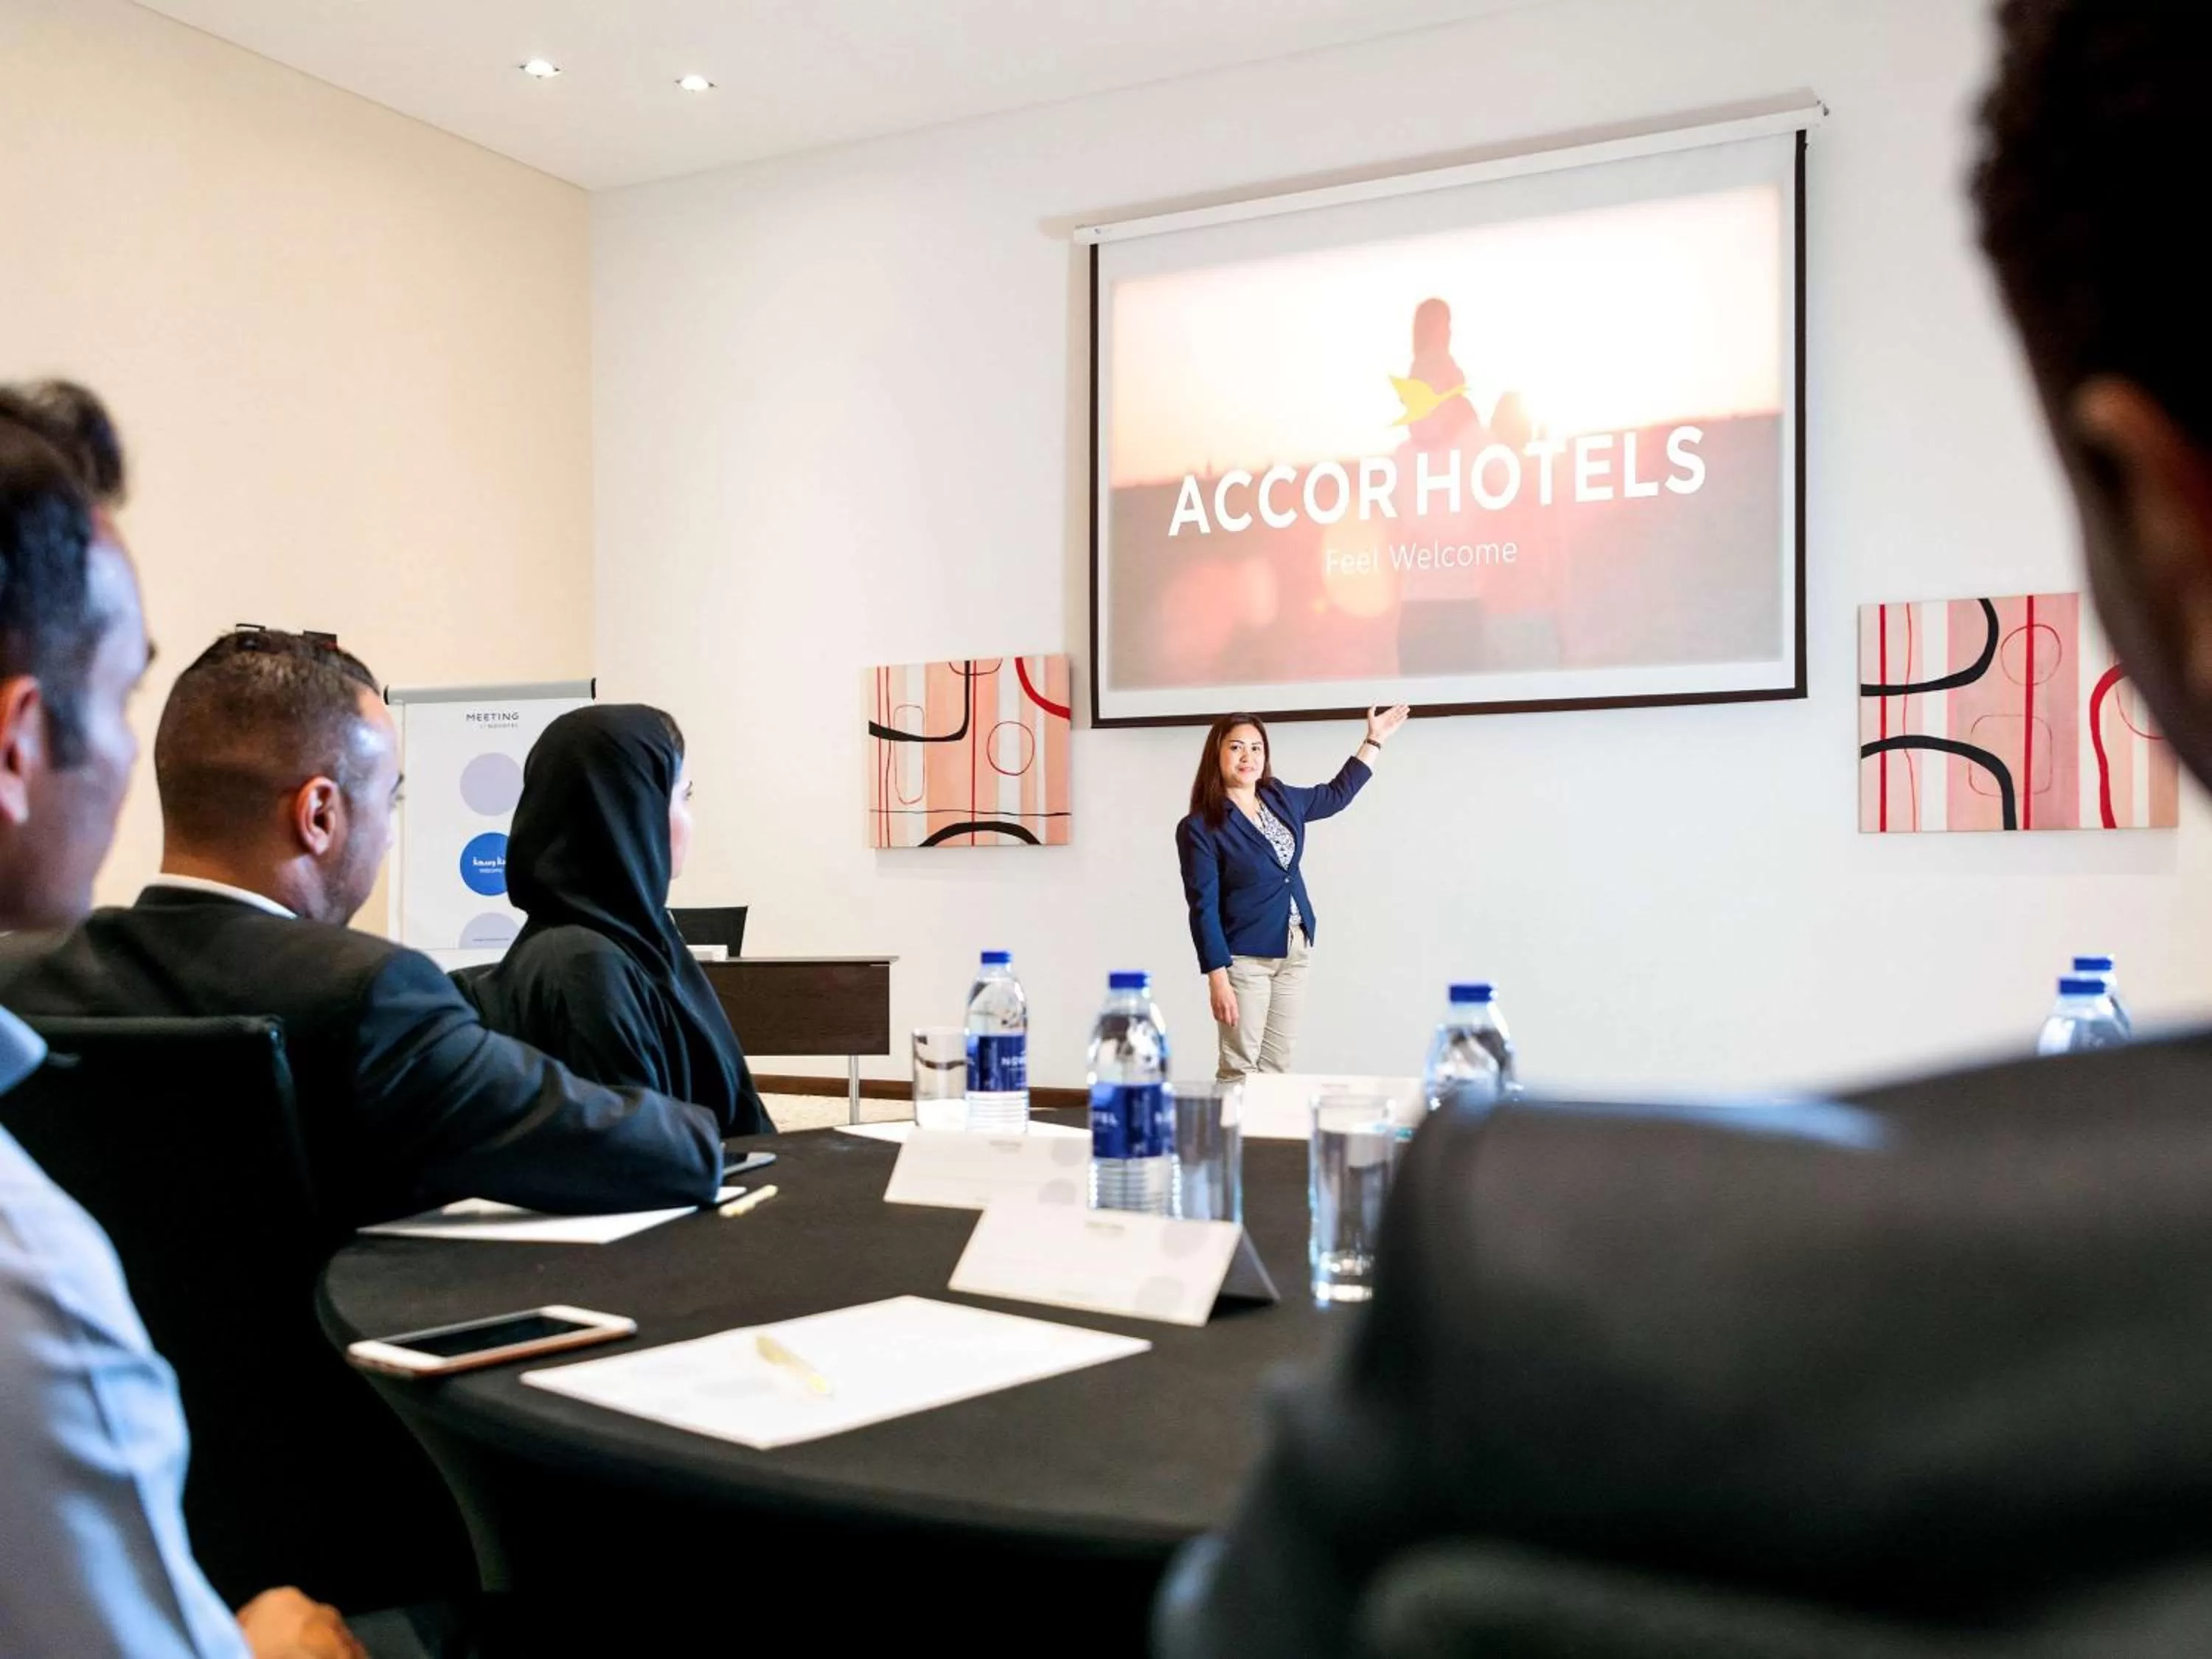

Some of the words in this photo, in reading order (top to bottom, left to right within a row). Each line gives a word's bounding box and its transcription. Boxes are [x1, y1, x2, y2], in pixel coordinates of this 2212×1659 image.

[1168, 455, 1399, 537] ACCOR
[1416, 425, 1705, 515] HOTELS
[1326, 547, 1380, 577] Feel
[1389, 540, 1518, 571] Welcome
[466, 712, 519, 721] MEETING
